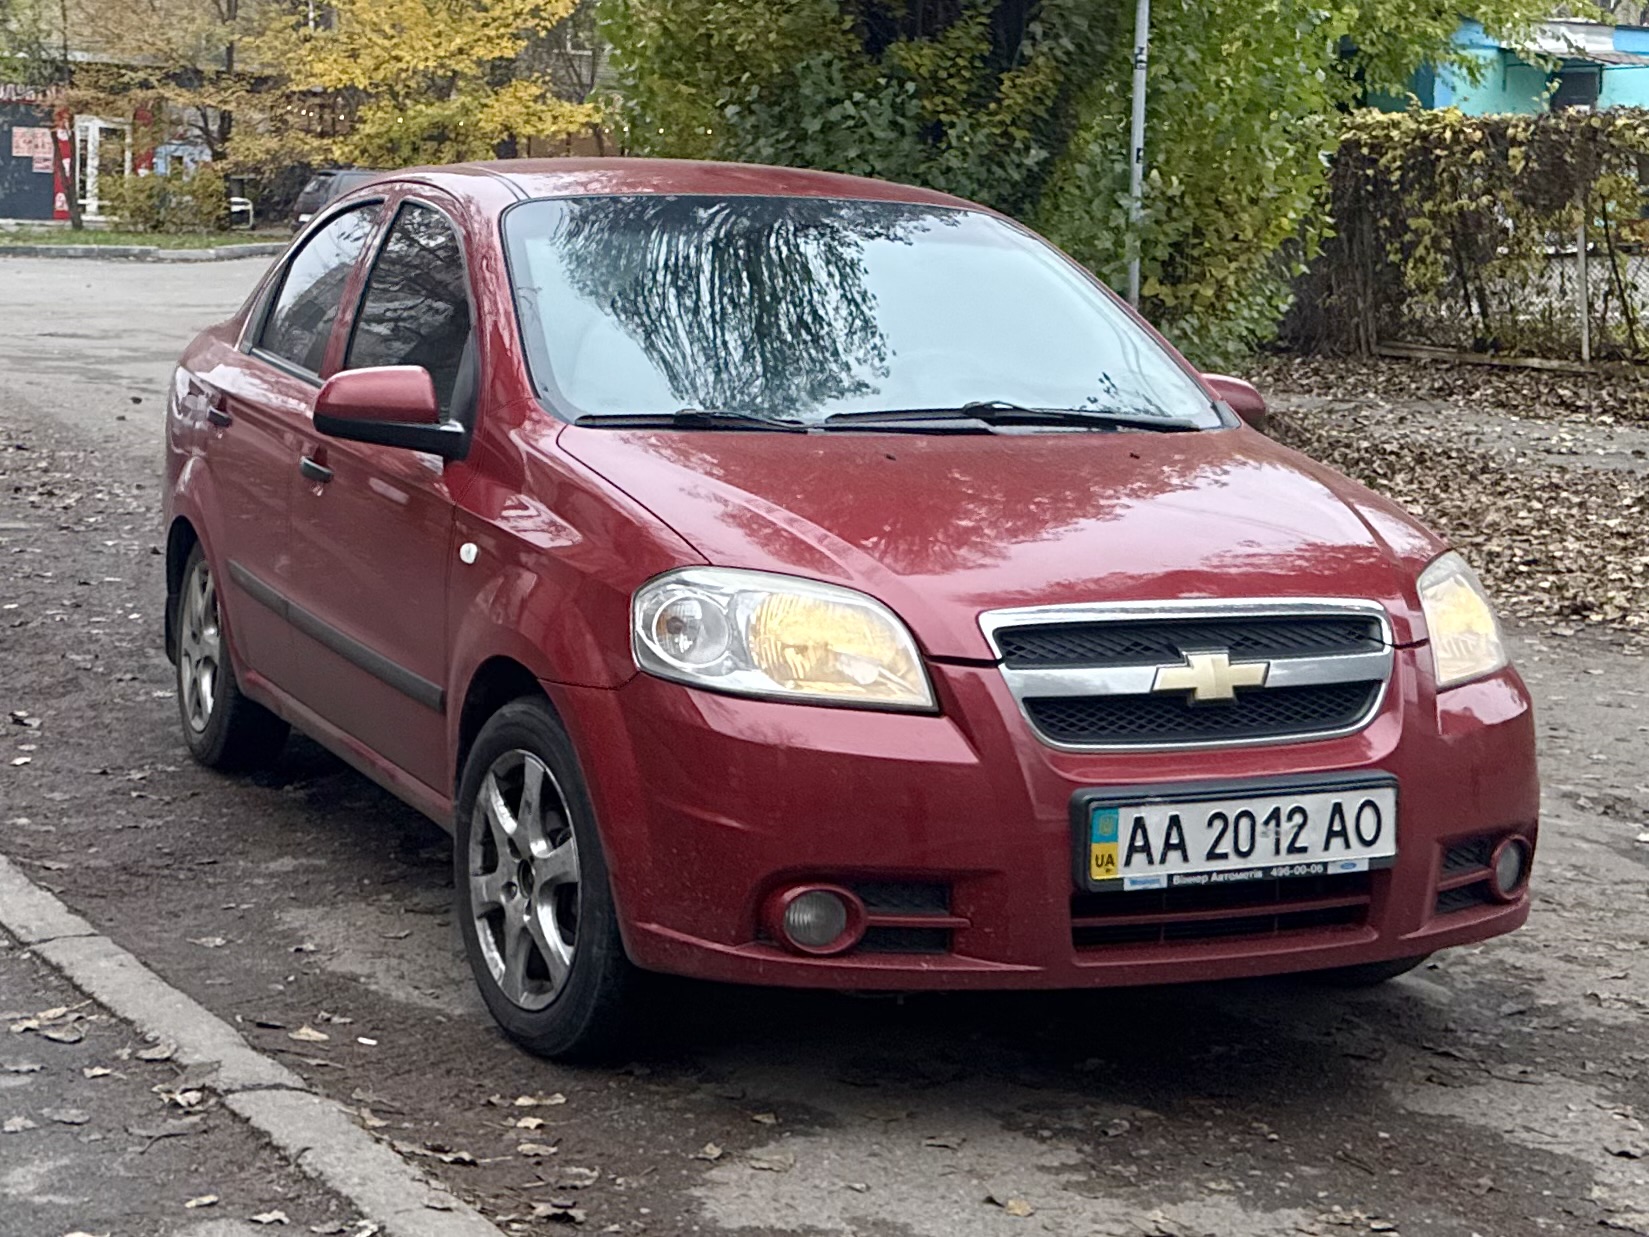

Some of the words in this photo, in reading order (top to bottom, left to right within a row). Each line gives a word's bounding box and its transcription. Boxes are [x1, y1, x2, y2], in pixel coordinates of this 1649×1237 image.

[1124, 813, 1189, 868] AA
[1204, 804, 1309, 861] 2012
[1323, 798, 1382, 852] AO
[1094, 853, 1115, 868] UA
